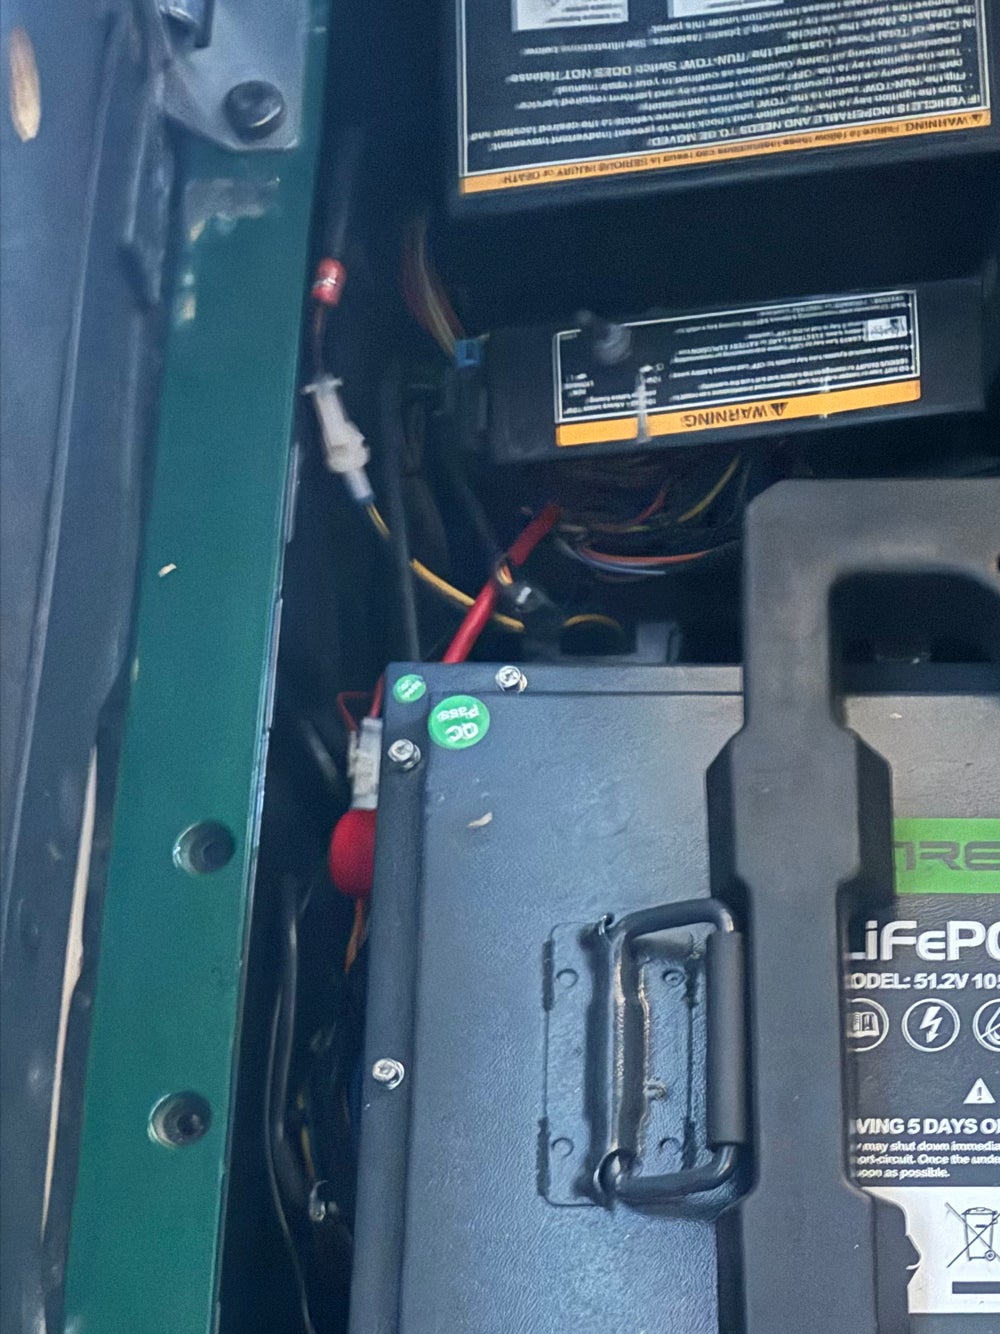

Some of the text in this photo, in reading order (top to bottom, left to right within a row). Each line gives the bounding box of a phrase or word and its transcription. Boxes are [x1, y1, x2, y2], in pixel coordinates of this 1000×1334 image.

[898, 104, 910, 114] IS
[912, 96, 967, 112] VEHICLE
[740, 121, 782, 135] NEEDS
[785, 117, 811, 129] AND
[720, 127, 737, 138] TO
[684, 405, 768, 429] WARNING
[437, 704, 479, 722] Pass
[445, 722, 479, 743] QC
[850, 973, 910, 989] ODEL:
[913, 973, 969, 989] 51.2V
[908, 1119, 920, 1134] 5
[924, 1118, 977, 1135] DAYS
[862, 1143, 888, 1153] may
[890, 1141, 916, 1151] shut
[918, 1141, 949, 1151] down
[917, 1154, 949, 1164] Once
[951, 1154, 970, 1164] the
[885, 1169, 899, 1177] as
[899, 1167, 950, 1180] possible.
